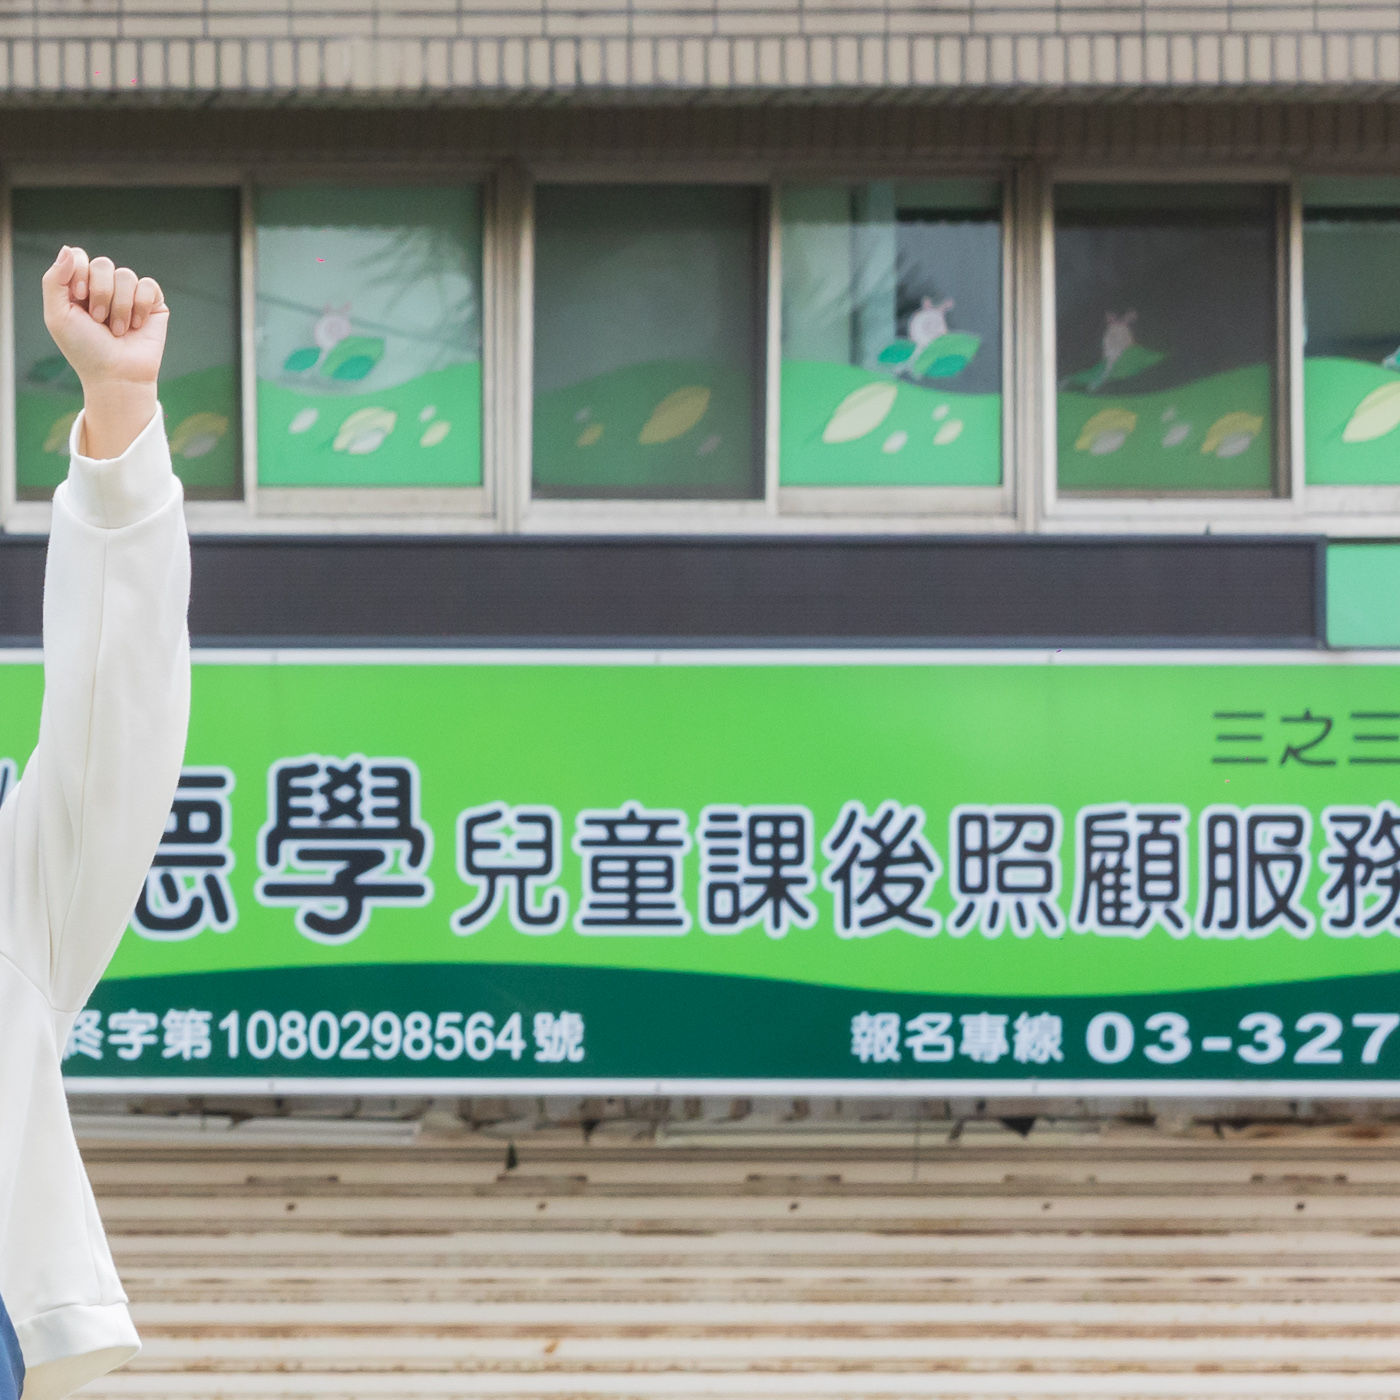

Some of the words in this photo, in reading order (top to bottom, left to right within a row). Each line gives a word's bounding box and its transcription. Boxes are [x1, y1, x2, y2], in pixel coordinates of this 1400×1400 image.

[1212, 708, 1400, 766] 三之三
[851, 1011, 1065, 1064] 報名專線
[1085, 1010, 1400, 1065] 03-327
